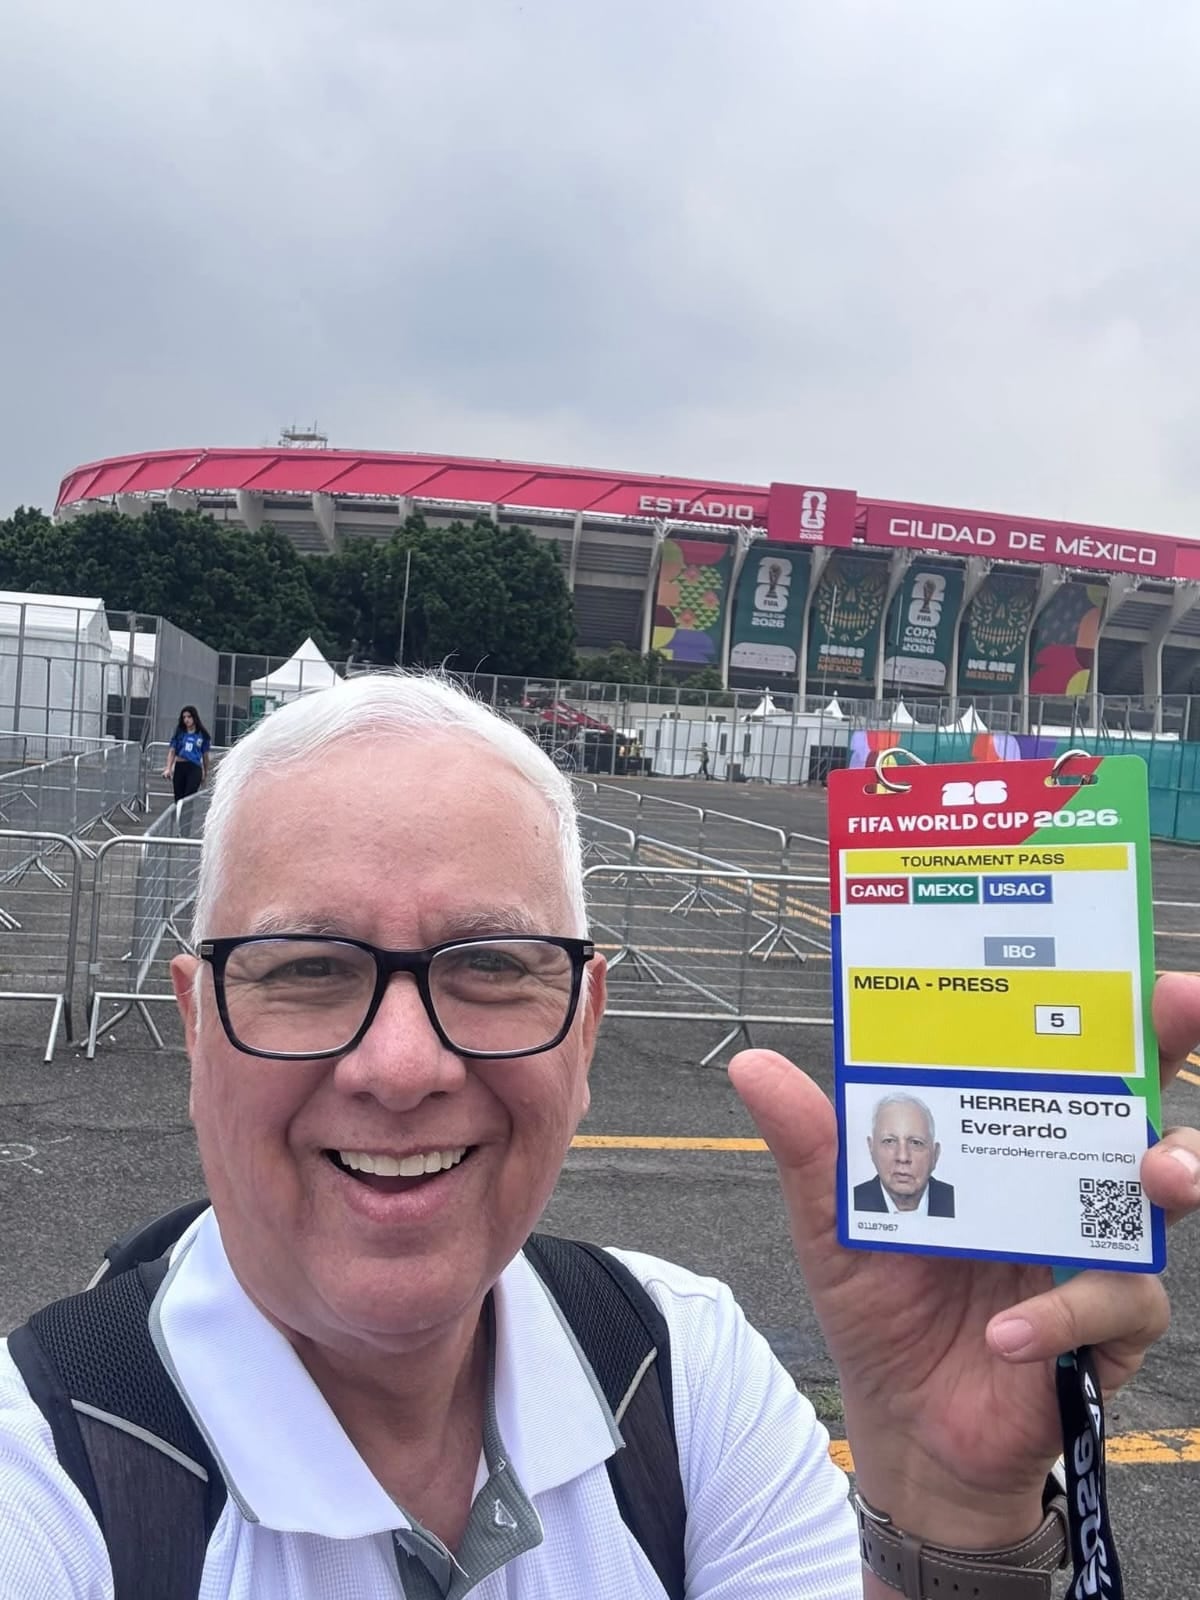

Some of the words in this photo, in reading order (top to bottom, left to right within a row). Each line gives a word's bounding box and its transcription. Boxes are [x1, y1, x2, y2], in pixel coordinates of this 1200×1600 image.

[639, 495, 754, 520] ESTADIO
[889, 518, 996, 546] CIUDAD
[1008, 531, 1046, 551] DE
[1055, 536, 1157, 566] MÉXICO
[751, 617, 785, 628] 2026
[905, 626, 937, 639] COPA
[902, 643, 934, 654] 2026
[942, 780, 1008, 806] 26
[848, 815, 894, 833] FIFA
[897, 813, 978, 832] WORLD
[982, 811, 1030, 829] CUP
[1033, 808, 1118, 829] 2026
[901, 855, 1014, 867] TOURNAMENT
[1019, 853, 1065, 865] PASS
[850, 884, 904, 898] CANC
[918, 883, 974, 897] MEXC
[989, 882, 1046, 896] USAC
[1003, 945, 1036, 959] IBC
[853, 976, 920, 991] MEDIA
[938, 977, 1009, 992] PRESS
[1050, 1013, 1065, 1028] 5
[960, 1095, 1063, 1114] HERRERA
[1068, 1100, 1131, 1118] SOTO
[961, 1119, 1067, 1139] Everardo
[961, 1144, 1099, 1161] EverardoHerrera.com
[1102, 1152, 1136, 1164] (CRC)
